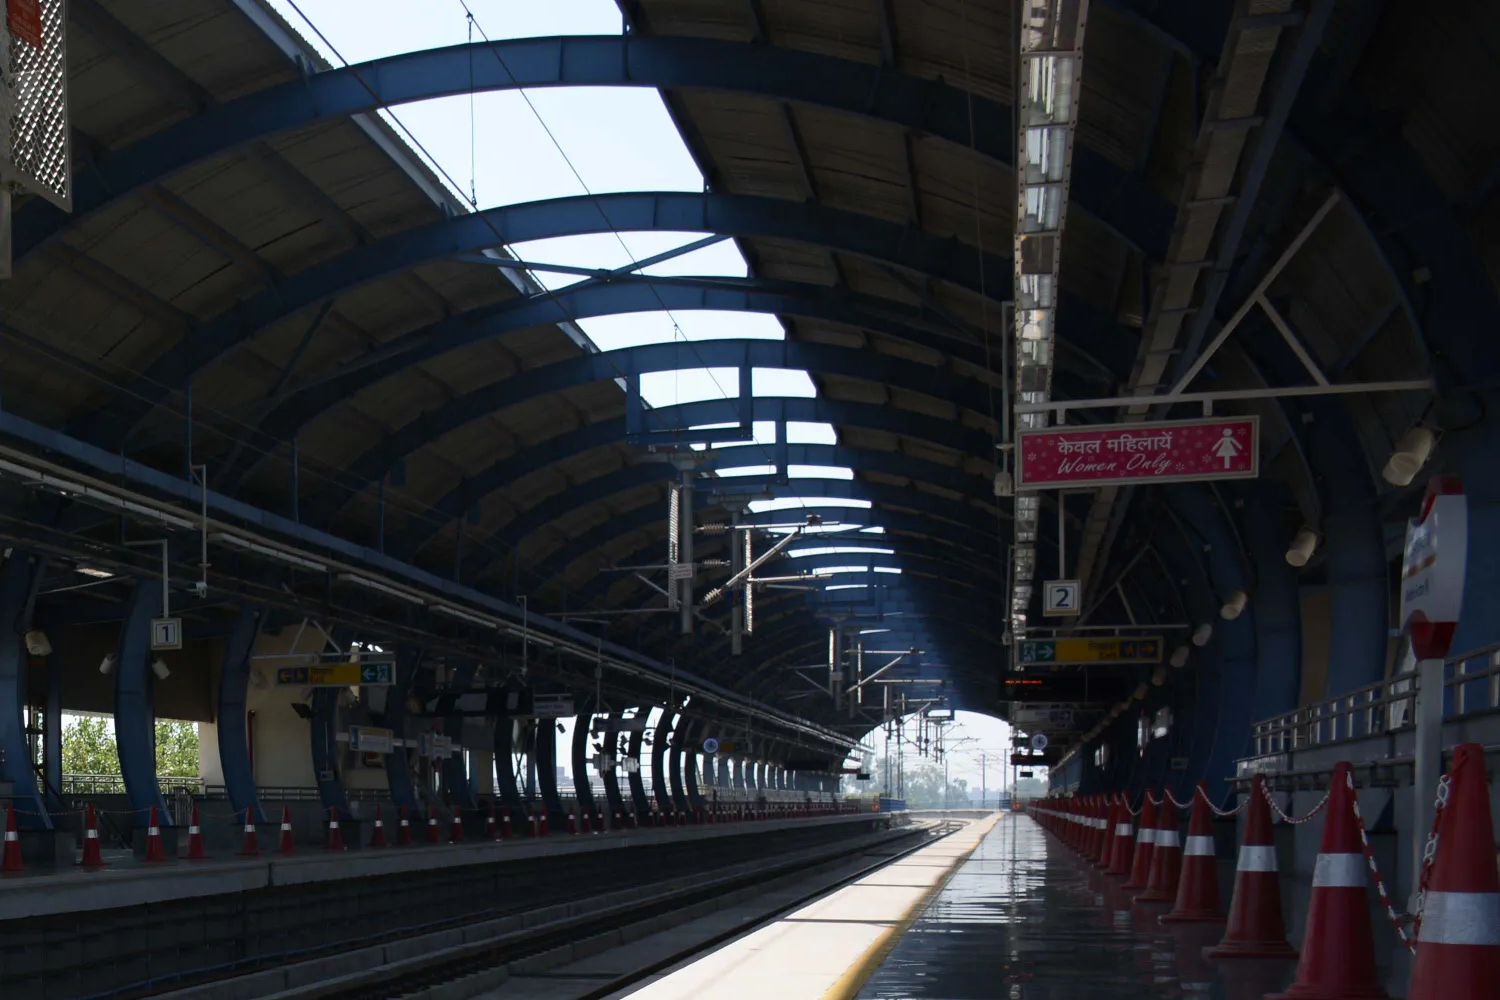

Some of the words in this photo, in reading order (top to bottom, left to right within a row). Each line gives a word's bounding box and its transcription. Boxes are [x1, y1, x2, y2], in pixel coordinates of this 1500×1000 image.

[1058, 436, 1101, 455] केवल
[1106, 431, 1172, 453] महिलायें
[1057, 456, 1117, 474] Women
[1126, 452, 1172, 475] Only
[1055, 588, 1069, 607] 2
[162, 625, 169, 641] 1
